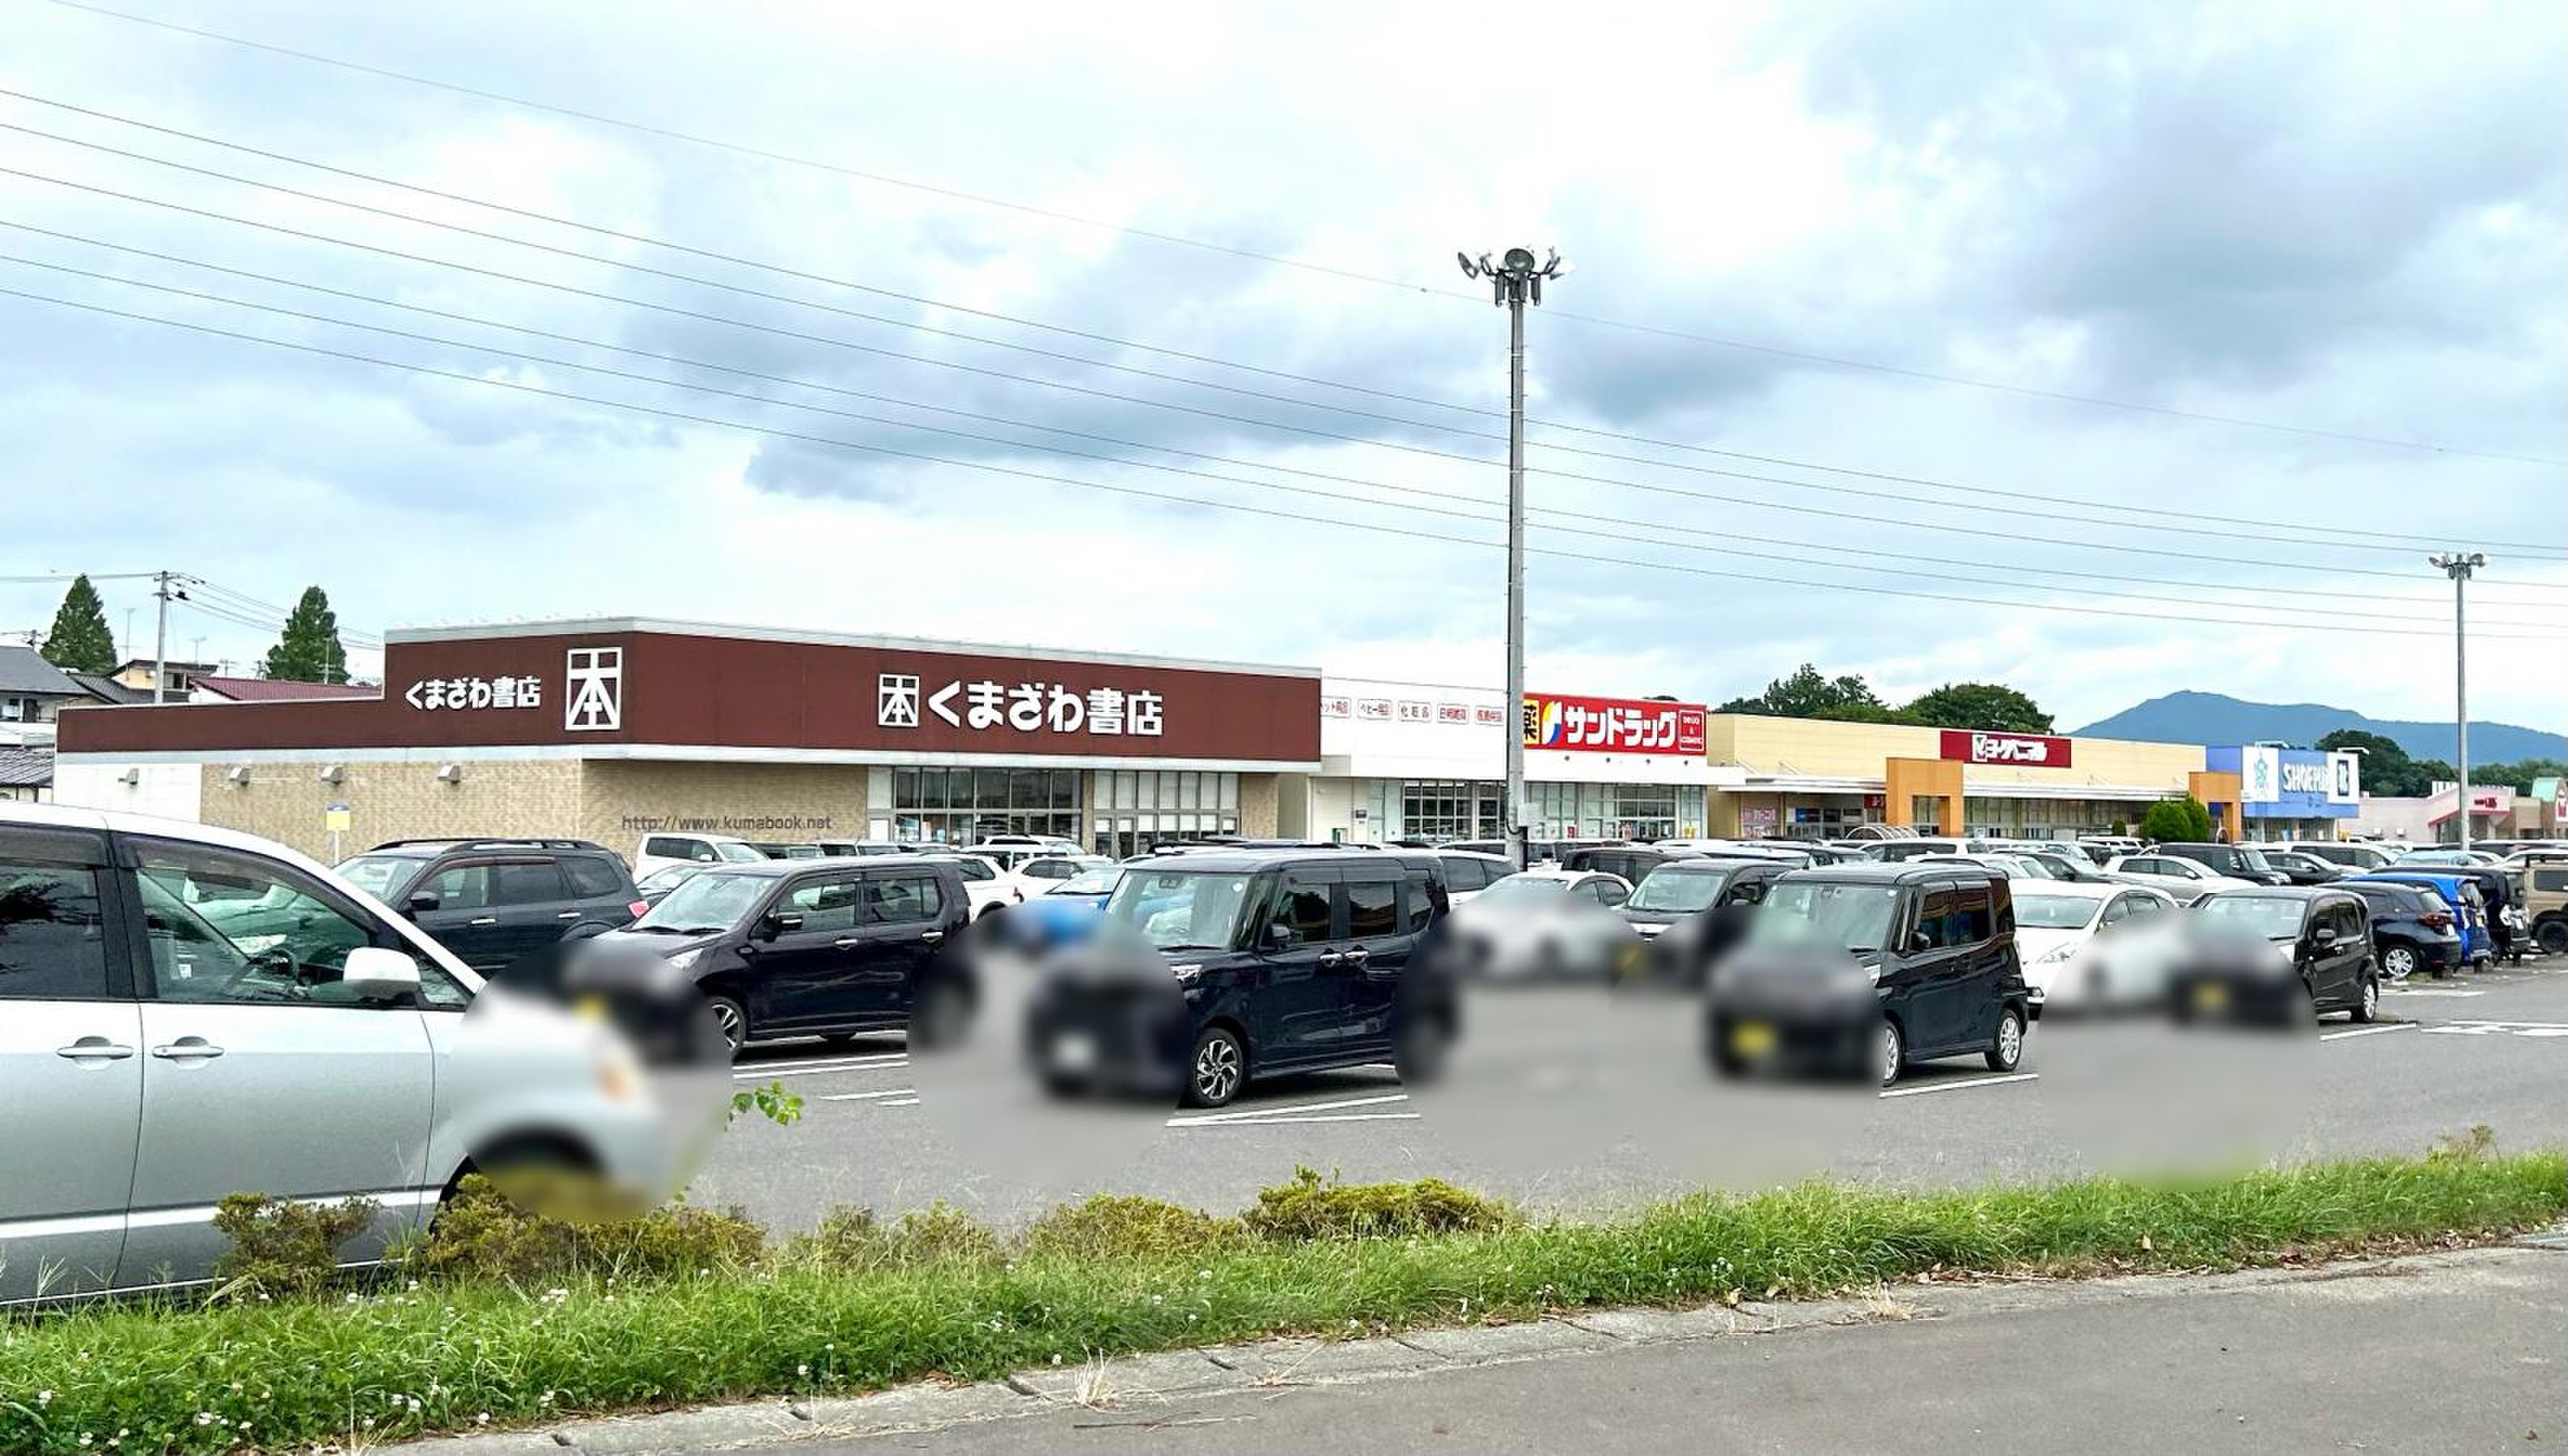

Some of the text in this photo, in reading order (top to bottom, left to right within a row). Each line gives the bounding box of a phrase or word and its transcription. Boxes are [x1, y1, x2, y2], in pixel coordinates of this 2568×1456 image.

[405, 675, 541, 710] くまざわ書店
[927, 679, 1163, 736] くまざわ書店
[1564, 705, 1677, 748] サンドラッグ
[621, 815, 832, 832] http://www.kumabook.net
